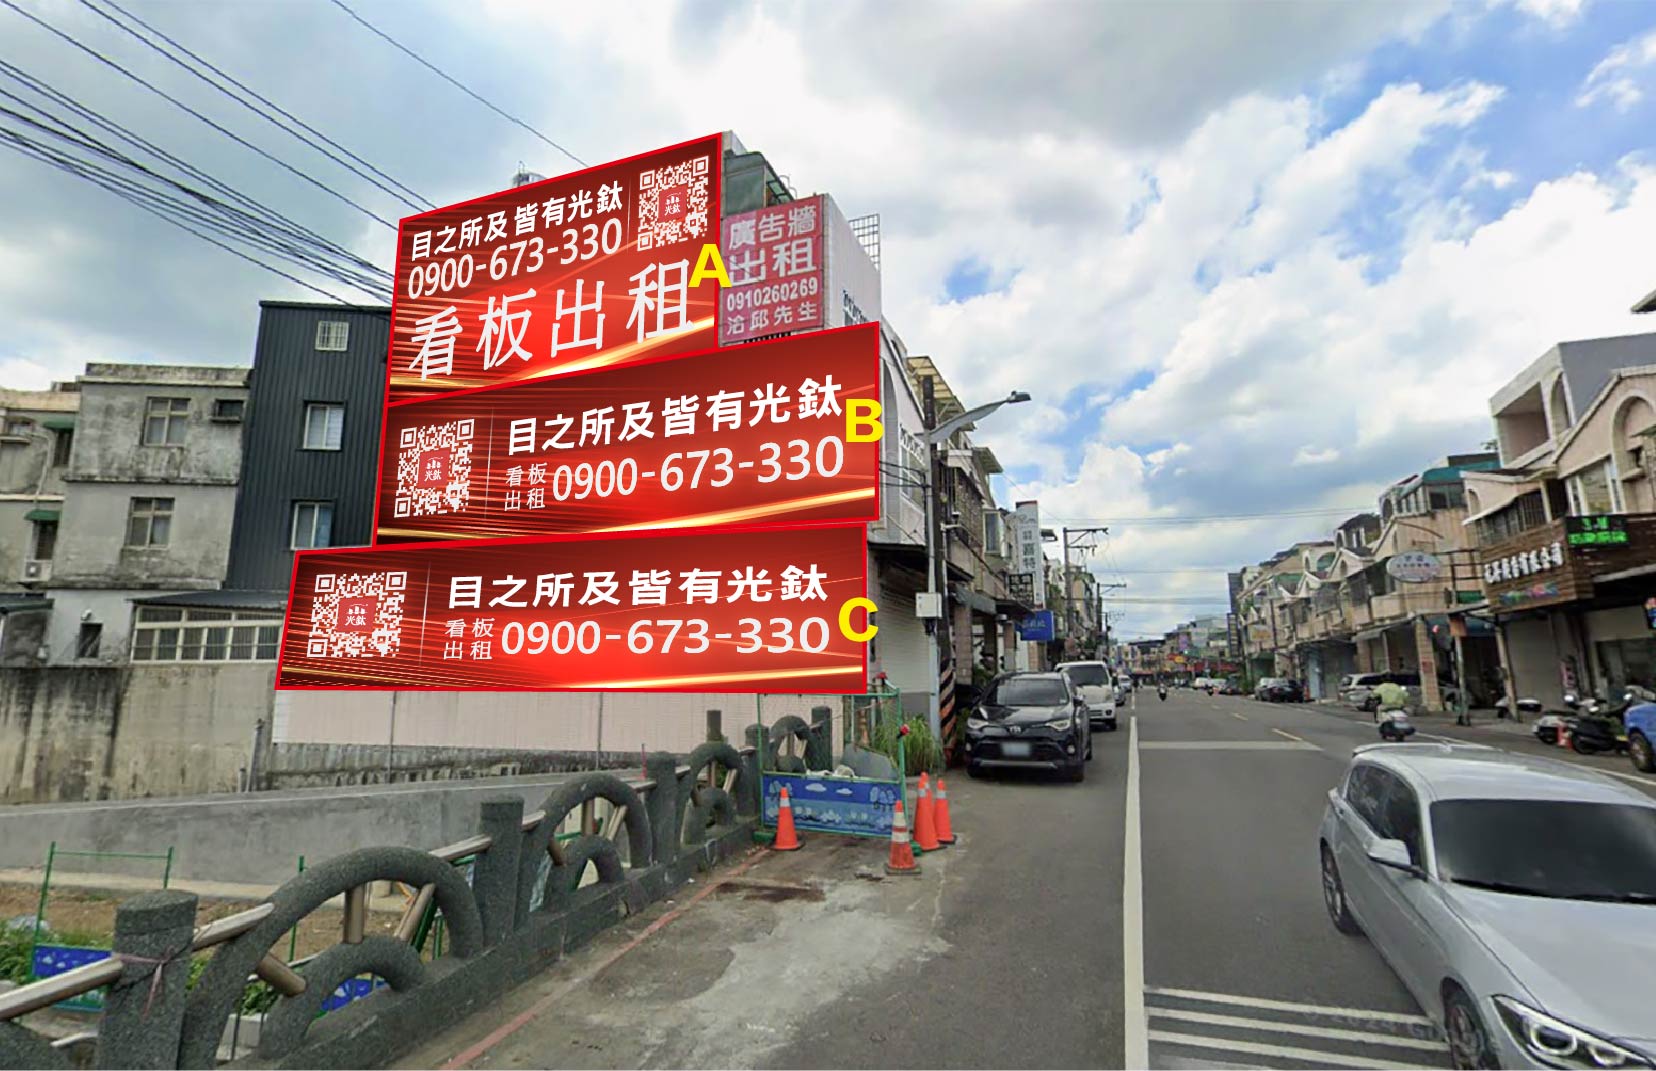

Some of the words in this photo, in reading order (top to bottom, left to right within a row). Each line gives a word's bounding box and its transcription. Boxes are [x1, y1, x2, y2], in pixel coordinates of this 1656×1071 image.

[411, 180, 624, 262] 目之所及皆有光鈦
[729, 205, 817, 250] 廣告牆
[408, 217, 623, 300] 0900-673-330
[729, 237, 817, 287] 出租
[727, 277, 818, 312] 0910260269
[408, 258, 695, 381] 看板出租
[727, 301, 817, 336] 洽邱先生
[509, 374, 844, 456] 目之所及皆有光鈦
[505, 462, 548, 488] 看板
[552, 435, 845, 502] 0900-673-330
[504, 487, 546, 512] 出租
[448, 564, 828, 609] 目之所及皆有光鈦
[443, 640, 493, 661] 出租
[444, 617, 495, 639] 看板
[502, 616, 830, 655] 0900-673-330
